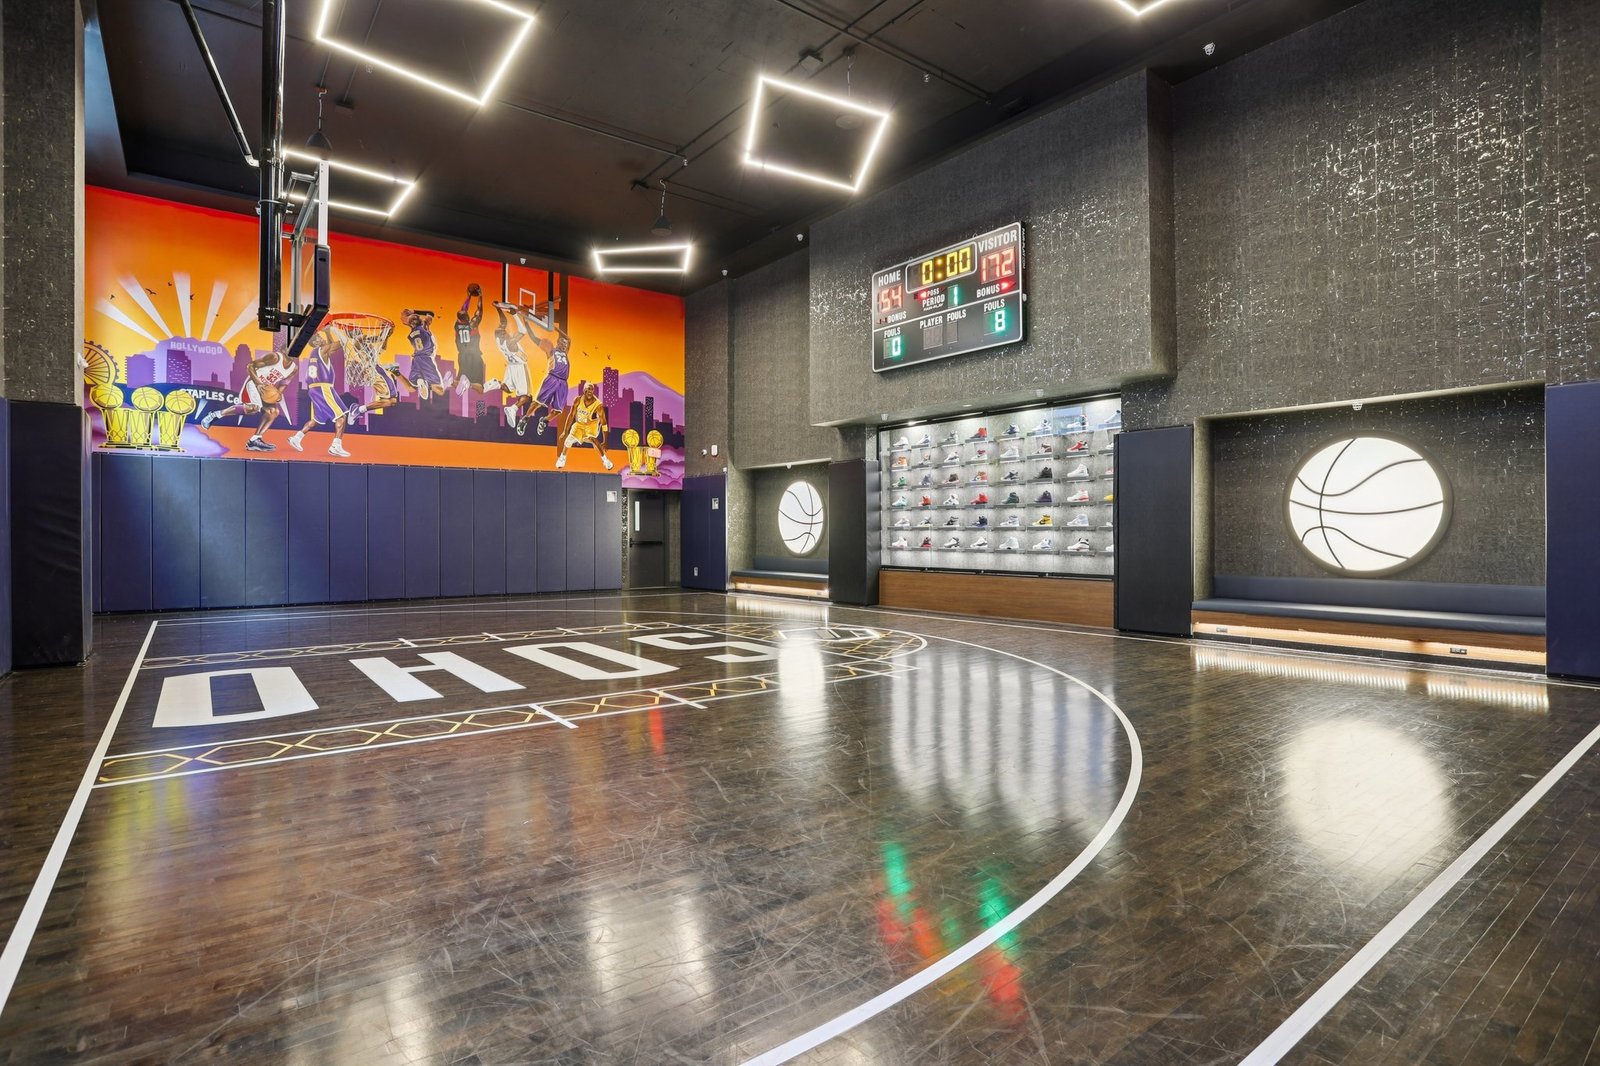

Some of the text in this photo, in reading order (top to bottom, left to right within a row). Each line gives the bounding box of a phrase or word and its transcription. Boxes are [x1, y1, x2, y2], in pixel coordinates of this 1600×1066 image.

[978, 229, 1018, 253] VISITOR
[921, 247, 971, 286] 0:00
[981, 247, 1015, 282] 172
[878, 270, 901, 287] HOME
[953, 285, 960, 307] 1
[976, 284, 1001, 298] BONUS
[922, 294, 946, 308] PERIOD
[983, 299, 1006, 313] FOULS
[887, 311, 907, 324] BONUS
[919, 309, 967, 330] PLAYER FOULS
[994, 310, 1006, 332] 8
[458, 329, 471, 344] 10
[883, 327, 901, 339] FOULS
[170, 341, 223, 355] HOLLYWOOD
[892, 336, 902, 357] 0
[180, 388, 225, 402] TAPLES
